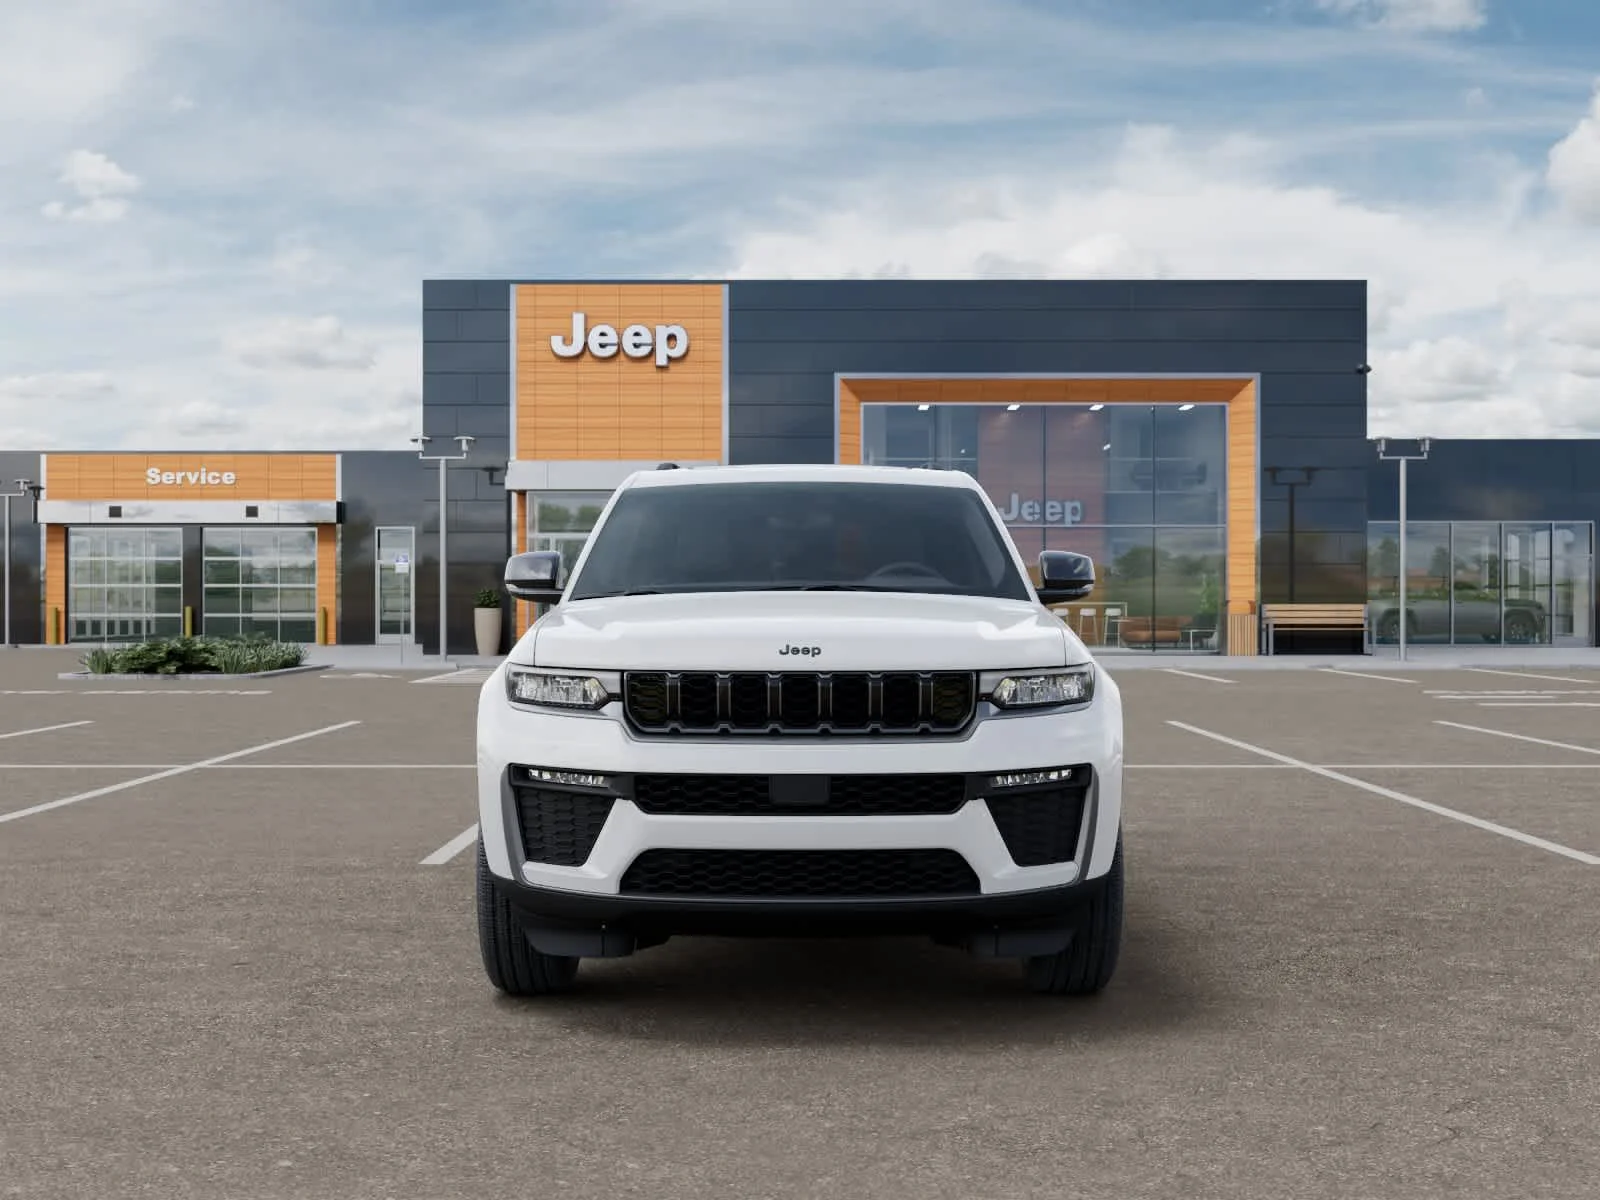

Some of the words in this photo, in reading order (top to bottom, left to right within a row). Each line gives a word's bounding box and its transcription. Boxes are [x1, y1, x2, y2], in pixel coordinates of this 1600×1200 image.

[550, 312, 690, 367] Jeep
[146, 466, 237, 486] Service
[998, 493, 1083, 527] Jeep
[779, 644, 822, 658] Jeep
